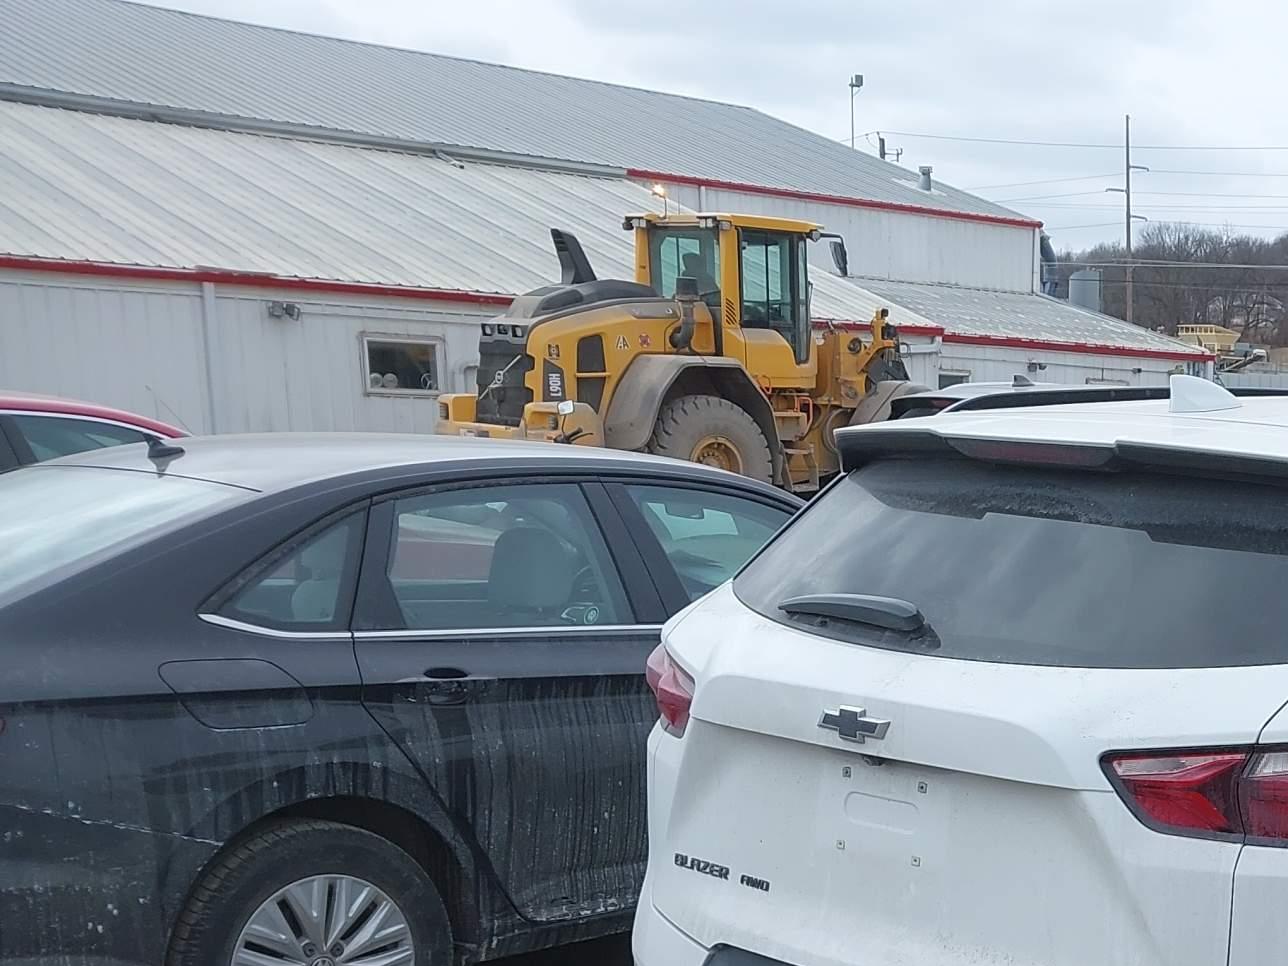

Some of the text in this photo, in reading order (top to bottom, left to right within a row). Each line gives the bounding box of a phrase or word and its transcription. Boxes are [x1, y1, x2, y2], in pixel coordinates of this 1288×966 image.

[548, 374, 562, 396] L90H
[674, 853, 770, 892] BLAZER AWD
